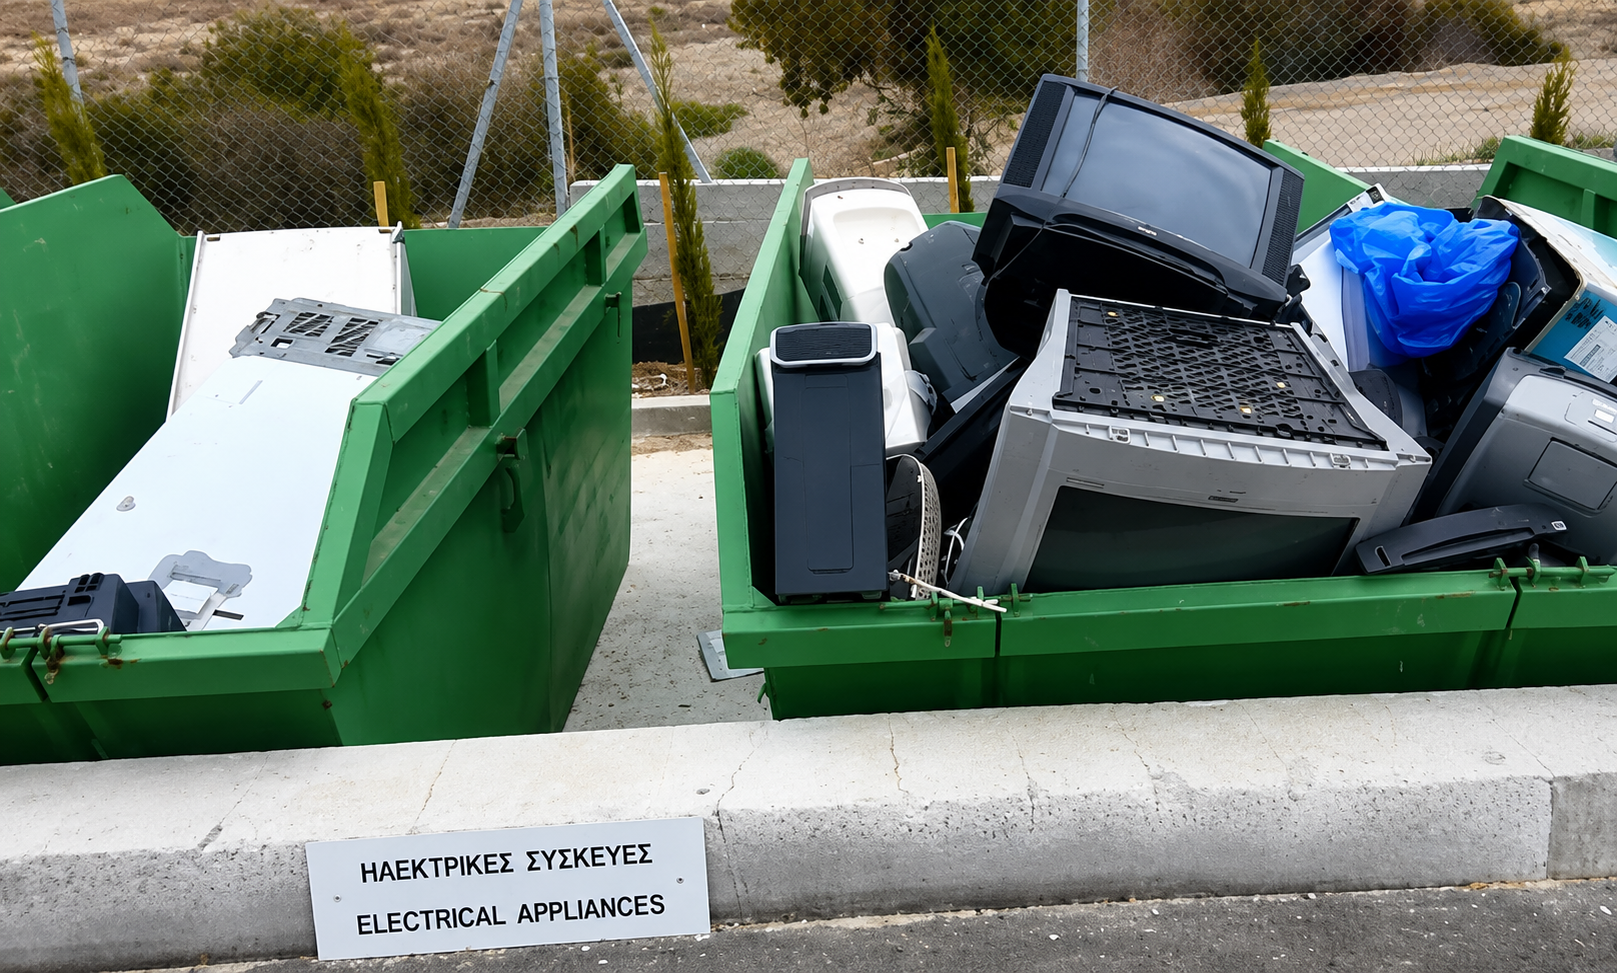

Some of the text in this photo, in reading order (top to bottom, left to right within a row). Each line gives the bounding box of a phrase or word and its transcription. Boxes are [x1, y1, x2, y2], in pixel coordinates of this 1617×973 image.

[526, 843, 653, 872] ΣΥΣΚΕΥΕΣ
[356, 894, 665, 936] ELECTRICAL APPLIANCES
